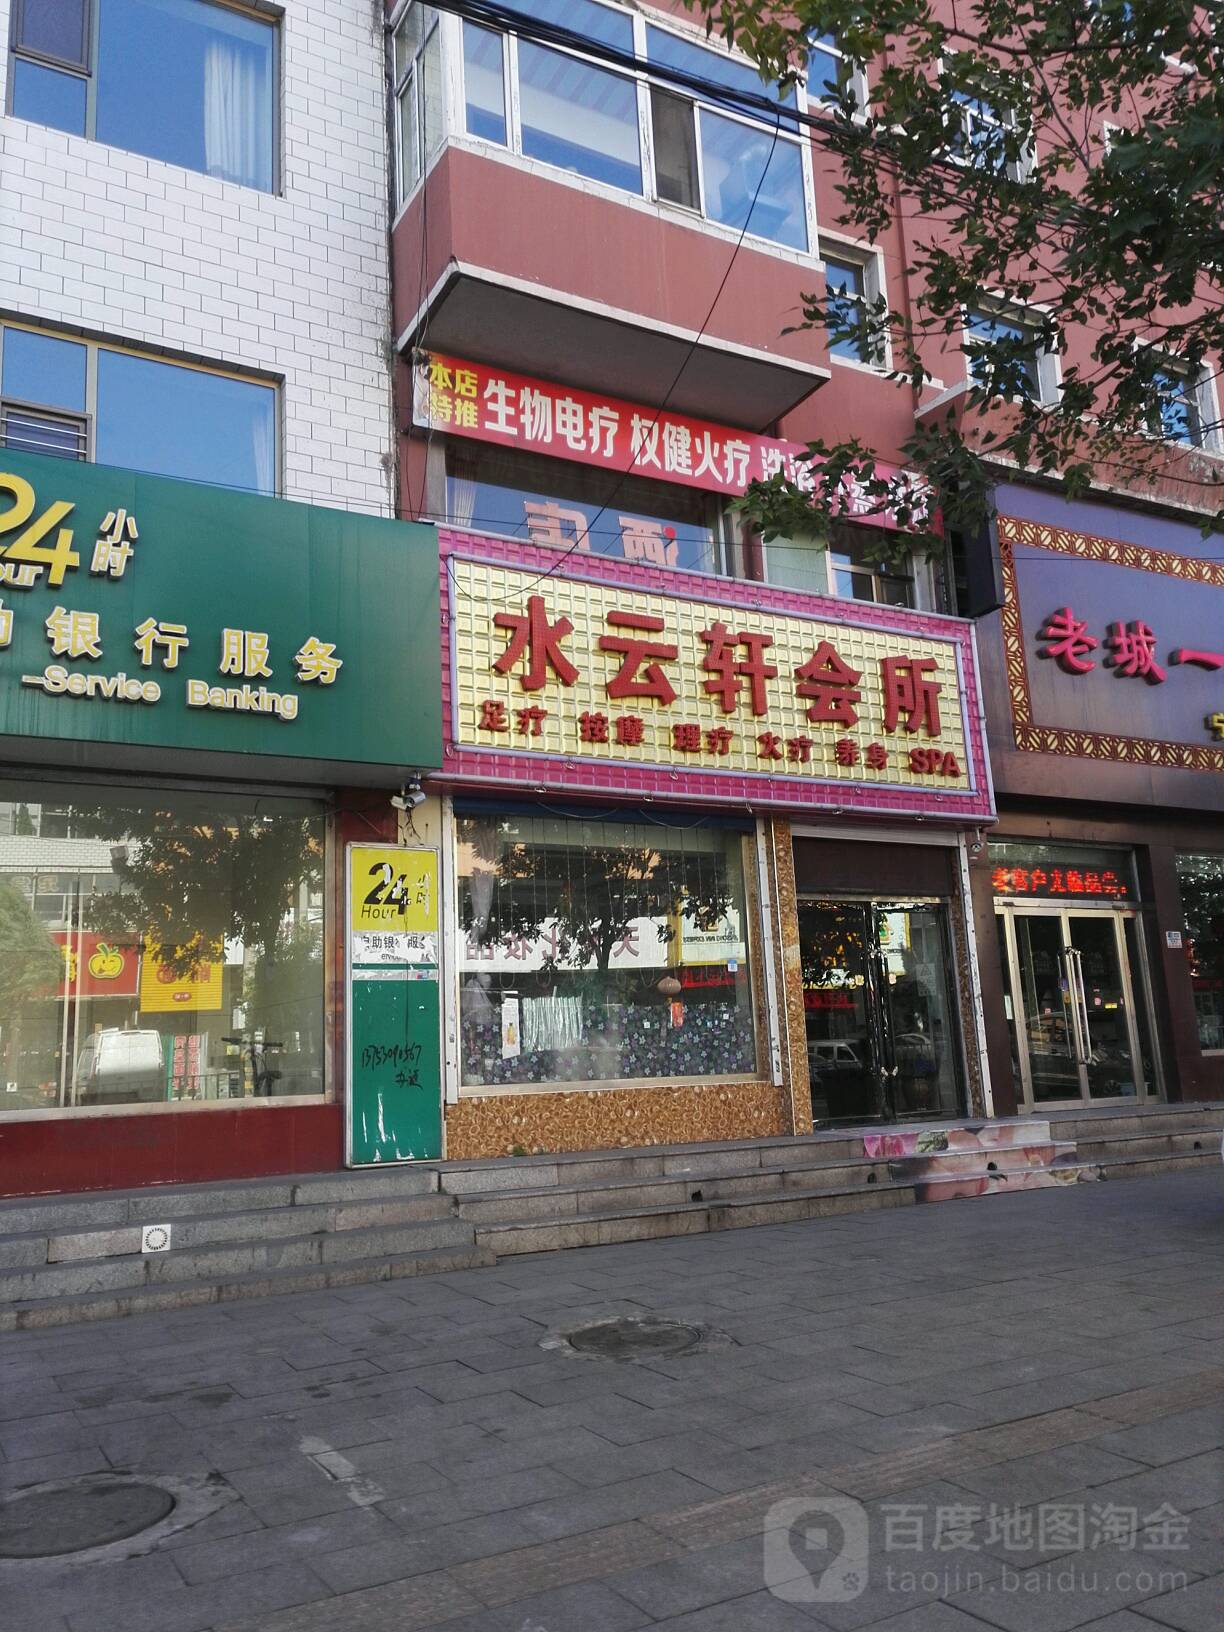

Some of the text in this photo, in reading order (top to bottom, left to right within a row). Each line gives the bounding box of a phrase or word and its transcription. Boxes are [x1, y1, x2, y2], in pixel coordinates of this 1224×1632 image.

[430, 363, 478, 398] 本店
[430, 392, 478, 428] 特推
[483, 379, 620, 458] 生物电疗
[630, 413, 751, 488] 权健火疗
[91, 508, 138, 577] 小时
[492, 595, 943, 738] 水云轩会所
[186, 678, 299, 721] Banking
[478, 700, 963, 779] 足疗 按摩 理疗 火疗 养身 SPA
[361, 905, 396, 919] Hour
[363, 862, 412, 915] 24
